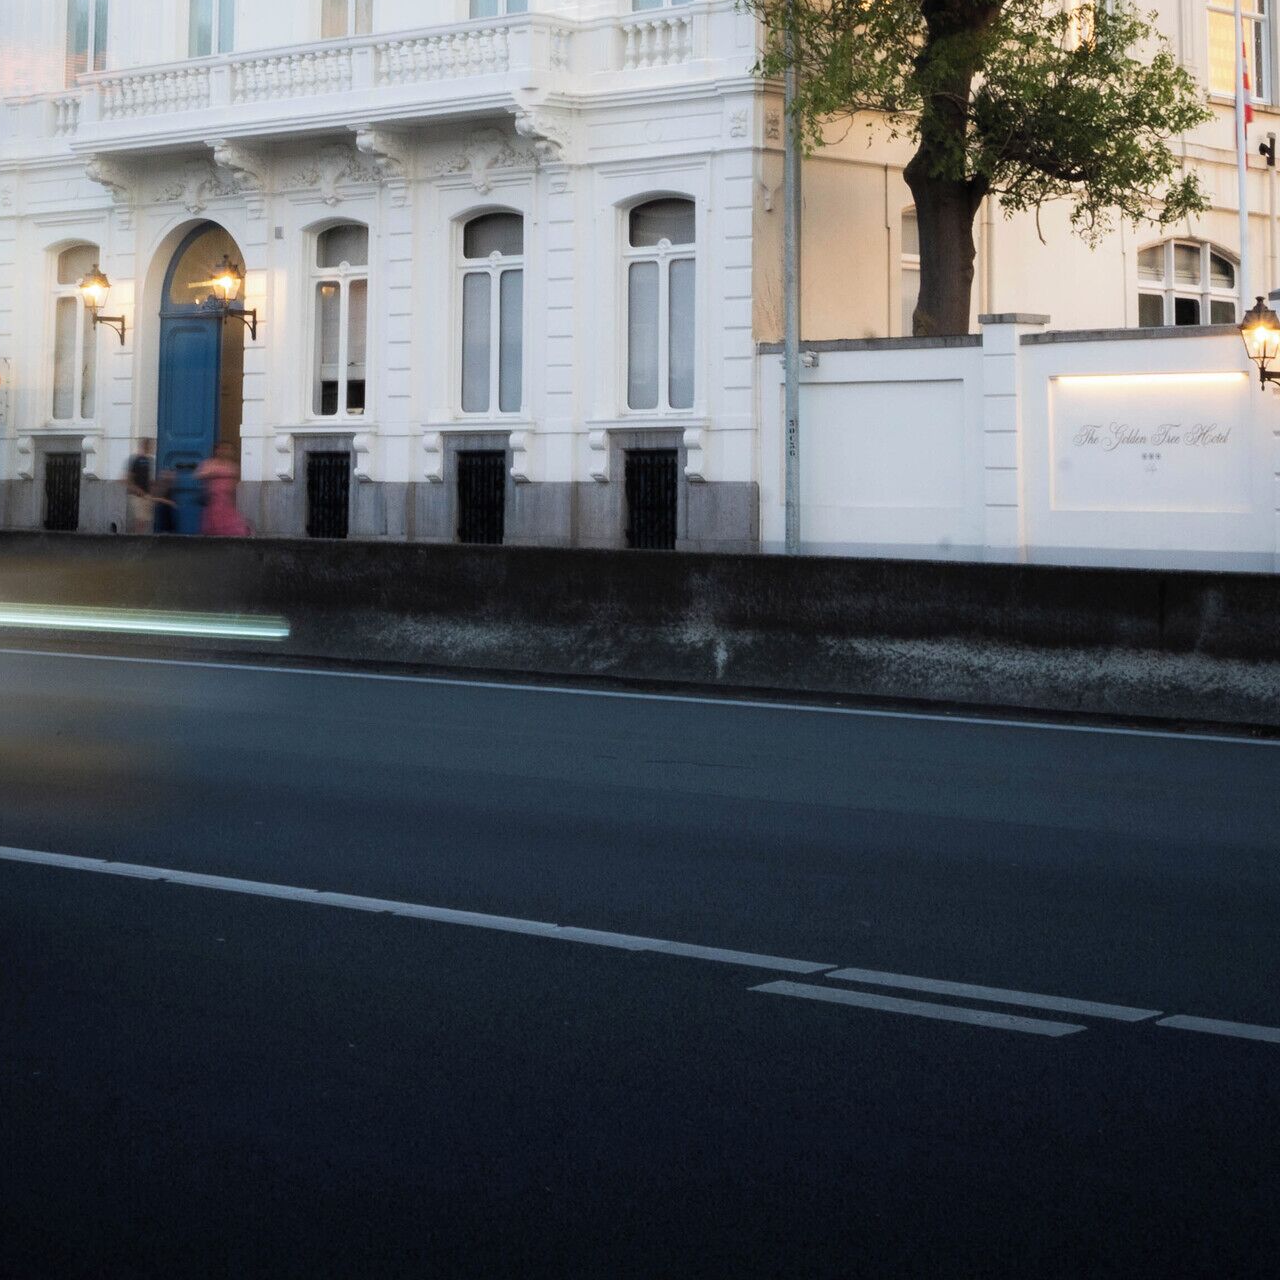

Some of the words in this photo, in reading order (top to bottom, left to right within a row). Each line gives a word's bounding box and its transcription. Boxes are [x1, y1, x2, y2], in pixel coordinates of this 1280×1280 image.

[1072, 424, 1103, 447] The
[1102, 421, 1147, 452] Golden
[1151, 423, 1181, 446] Tree
[1183, 422, 1232, 447] Hotel
